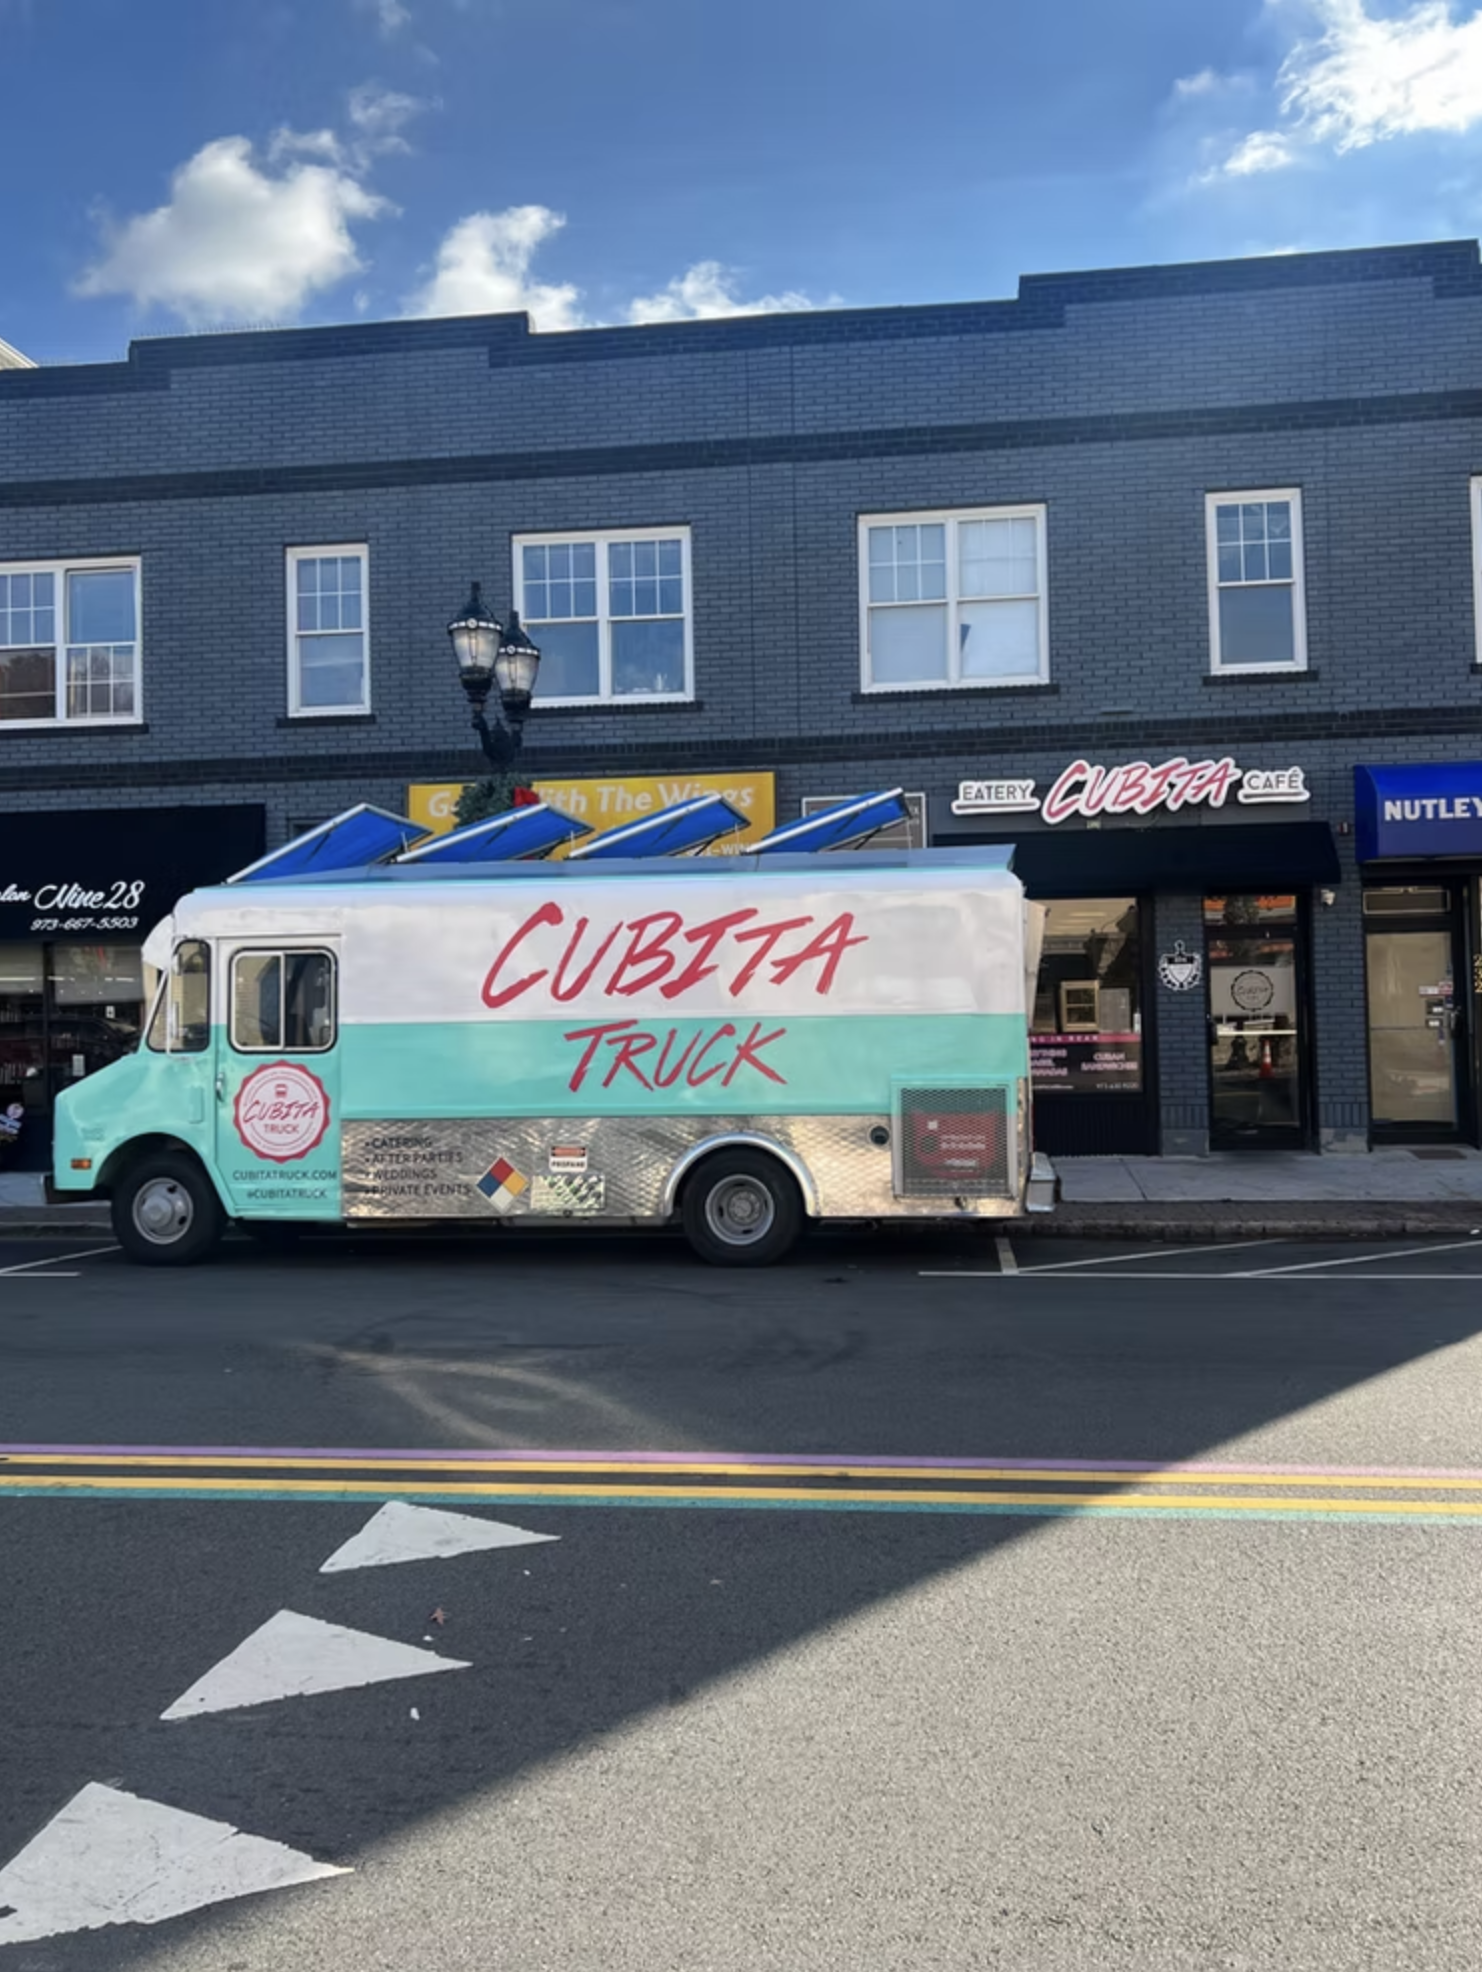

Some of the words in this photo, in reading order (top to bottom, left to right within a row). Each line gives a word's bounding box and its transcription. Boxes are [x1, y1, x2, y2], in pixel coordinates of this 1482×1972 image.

[962, 784, 1031, 801] EATERY
[1046, 762, 1235, 818] CUBITA
[1247, 769, 1300, 790] CAFÉ
[597, 785, 652, 812] The
[30, 916, 139, 931] 973-667-5503
[481, 902, 869, 1009] CUBITA
[564, 1019, 788, 1092] TRUCK
[242, 1099, 320, 1123] CUBITA
[263, 1123, 300, 1134] TRUCK
[372, 1137, 433, 1149] CATERING
[373, 1152, 411, 1165] AFTER
[413, 1150, 463, 1164] PARTIES
[232, 1169, 338, 1181] CUBITATRUCK.COM
[373, 1167, 438, 1180] WEDDINGS
[246, 1188, 327, 1200] @CUBITATRUCK
[373, 1184, 420, 1196] PRIVATE
[423, 1183, 471, 1196] EVENTS
